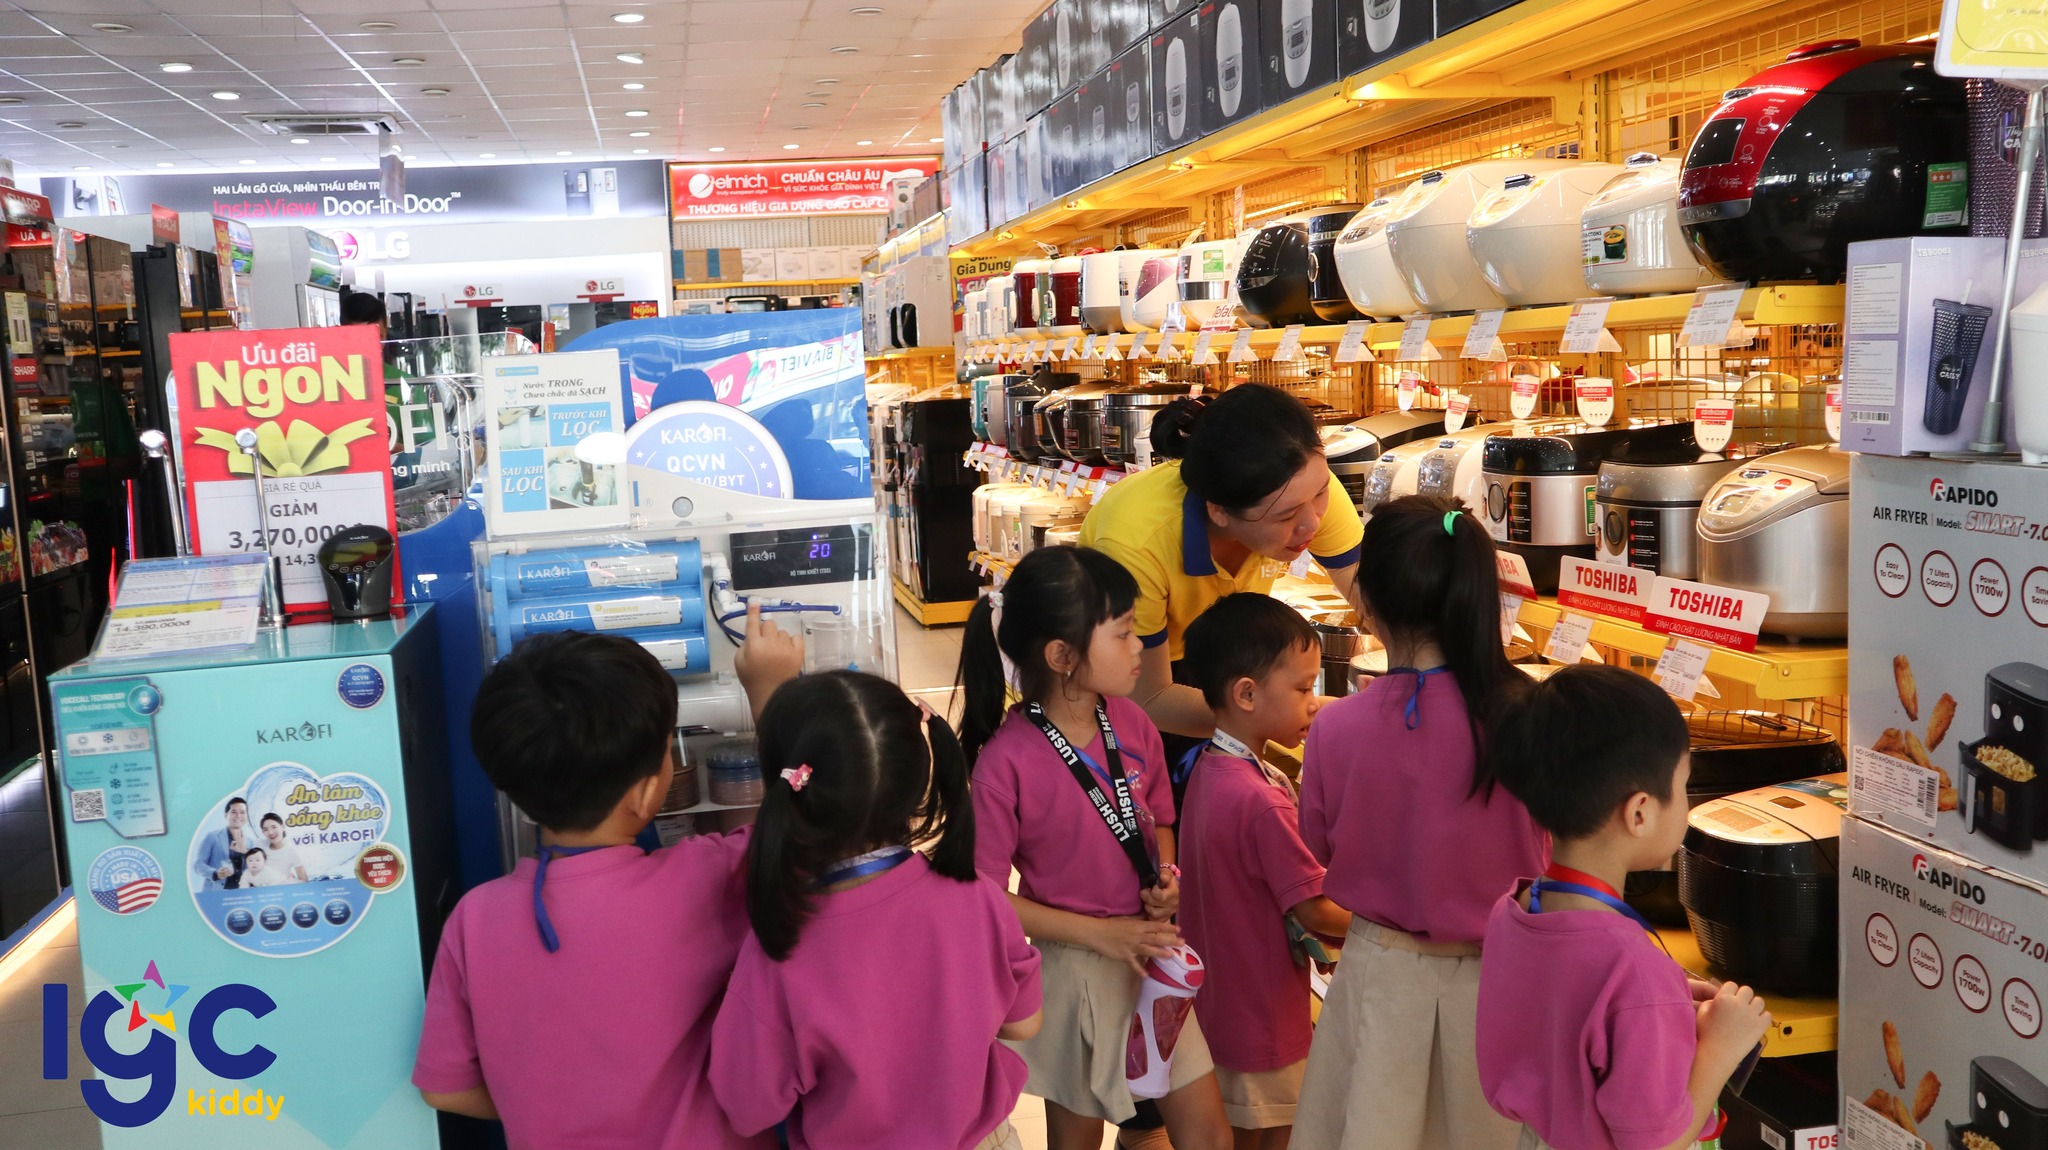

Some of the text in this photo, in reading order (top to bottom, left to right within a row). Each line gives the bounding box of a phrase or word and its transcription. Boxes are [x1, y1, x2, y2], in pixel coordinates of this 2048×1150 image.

[715, 173, 768, 190] elmich
[827, 169, 862, 182] CHÂU
[863, 168, 881, 182] ÂU
[213, 186, 231, 195] HAI
[346, 180, 367, 191] BÊN
[213, 199, 317, 218] InstaView
[768, 201, 790, 212] GIA
[365, 232, 410, 259] LG
[956, 260, 1012, 276] Gia Dụng
[477, 286, 494, 298] LG
[600, 281, 615, 290] LG
[241, 342, 316, 366] Ưu đãi
[13, 365, 36, 376] SHARP
[196, 354, 367, 418] NgoN
[548, 378, 584, 388] TRONG
[552, 408, 607, 420] TRƯỚC KHI
[661, 422, 727, 445] KAROFI
[411, 461, 451, 474] minh
[501, 464, 544, 476] SAU KHI
[666, 454, 726, 473] QCVN
[504, 476, 544, 497] LỌC
[1930, 478, 1998, 508] RAPIDO
[270, 499, 318, 518] GIẢM
[1872, 506, 1892, 521] AIR
[1895, 508, 1928, 526] FRYER
[1936, 518, 1962, 530] Model:
[743, 550, 776, 562] KAROFI
[810, 543, 831, 559] 20
[285, 554, 318, 566] 14,3
[1886, 561, 1899, 571] Easy
[527, 566, 571, 580] KAROFI
[1576, 565, 1638, 596] TOSHIBA
[1880, 570, 1906, 581] To Clean
[1934, 570, 1950, 579] Liters
[1980, 575, 2000, 586] Power
[1926, 578, 1954, 590] Capacity
[1975, 584, 2004, 598] 1700w
[1670, 588, 1743, 621] TOSHIBA
[531, 608, 575, 623] KAROFI
[257, 720, 333, 745] KAROFI
[1046, 728, 1079, 766] LUSH
[286, 784, 364, 806] An tâm
[1114, 778, 1134, 818] LUSH
[286, 806, 334, 830] sống
[1099, 803, 1131, 842] LUSH
[293, 829, 375, 846] với KAROFI
[110, 872, 140, 884] USA
[1912, 854, 1986, 905] RAPIDO
[1852, 866, 1872, 886] AIR
[1875, 870, 1910, 902] FRYER
[1920, 898, 1947, 918] Model:
[1870, 934, 1894, 953] To Clean
[1876, 929, 1888, 942] Easy
[1912, 956, 1938, 976] Capacity
[1962, 969, 1982, 984] Power
[1958, 976, 1985, 998] 1700w
[2014, 995, 2030, 1010] Time
[2011, 1003, 2033, 1022] Saving
[1808, 1135, 1838, 1150] TOS
